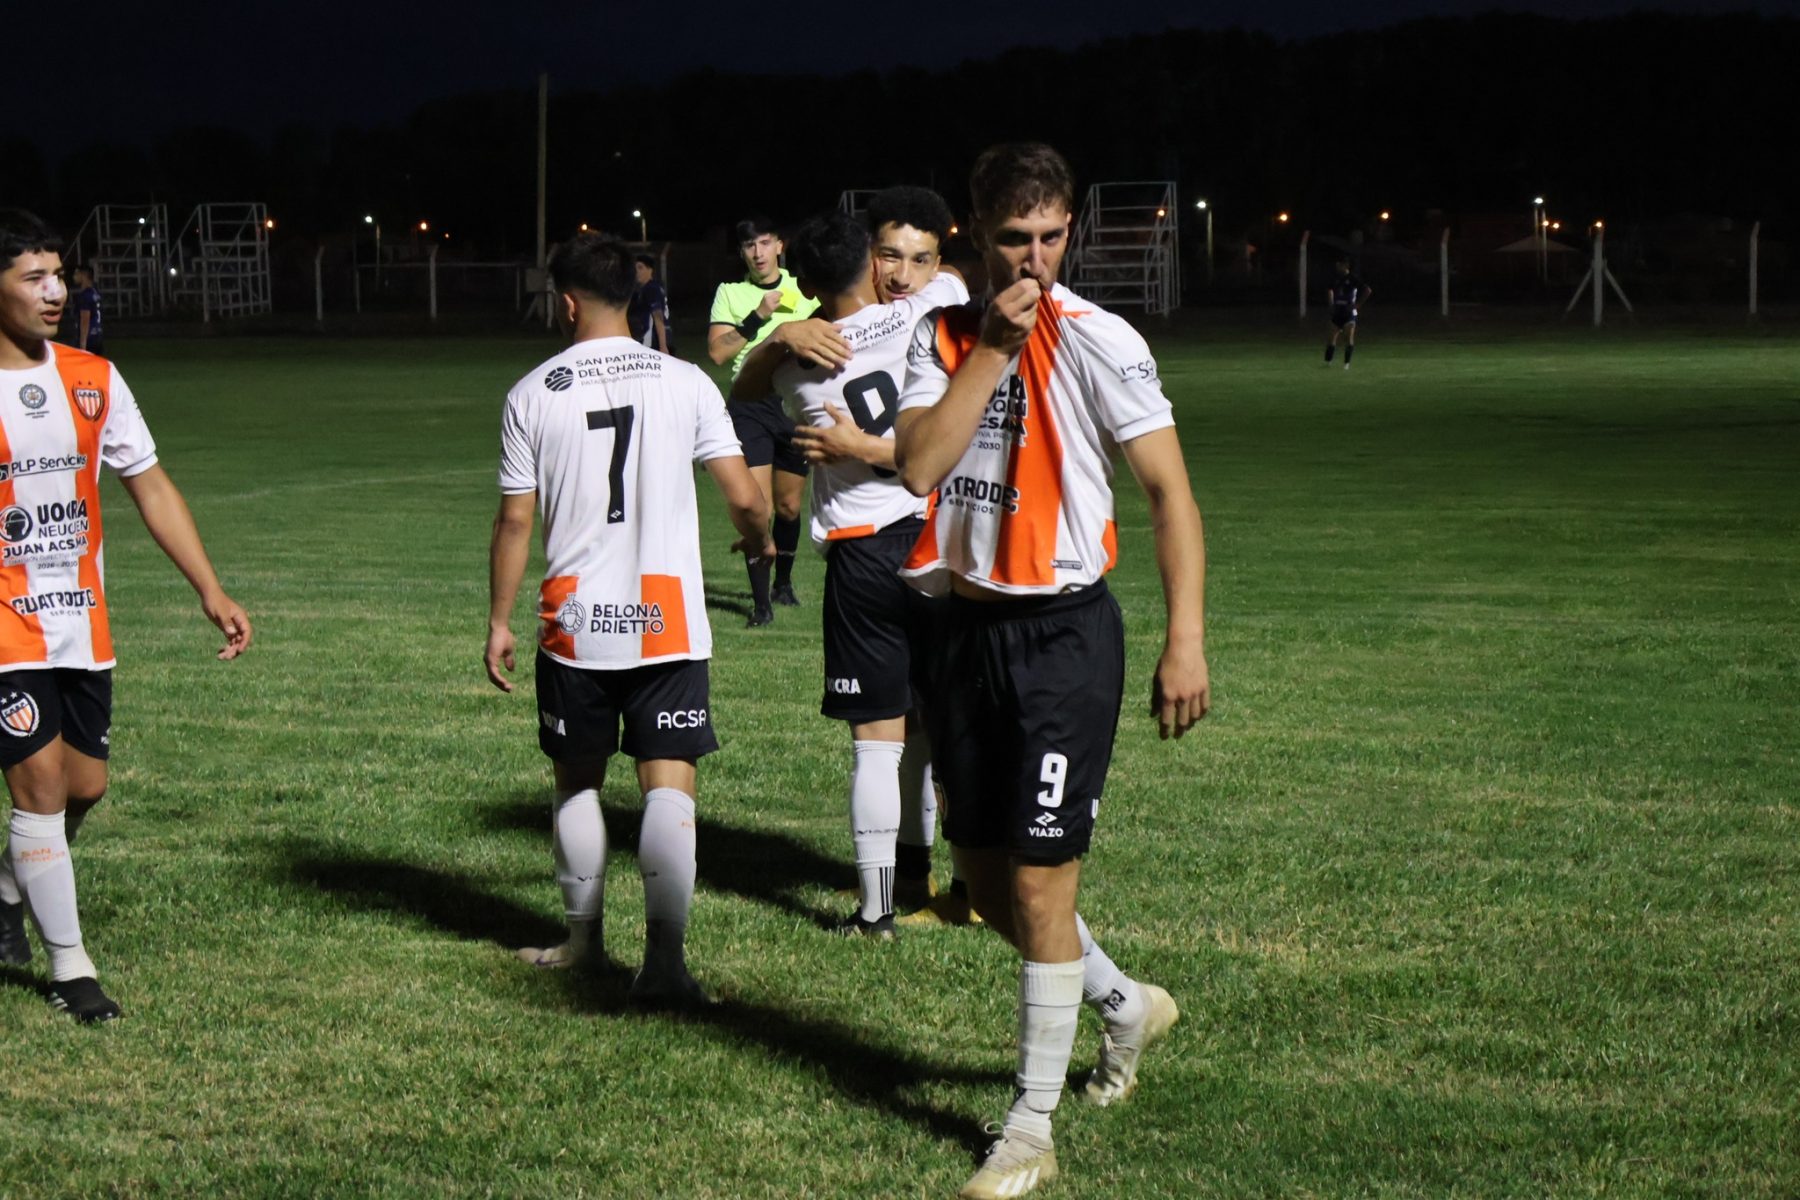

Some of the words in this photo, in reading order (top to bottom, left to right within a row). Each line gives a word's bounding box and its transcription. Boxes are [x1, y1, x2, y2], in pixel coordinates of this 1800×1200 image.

[576, 358, 602, 368] SAN
[605, 352, 662, 364] PATRICIO
[578, 367, 604, 379] DEL
[607, 360, 662, 375] CHAÑAR
[11, 459, 36, 474] PLP
[586, 405, 634, 524] 7
[37, 499, 87, 525] UOCRA
[38, 520, 88, 539] NEUEN
[4, 543, 44, 559] JUAN
[593, 603, 662, 618] BELONA
[657, 709, 707, 730] ACSA
[1037, 752, 1068, 808] 9
[1028, 827, 1064, 838] VIAZO
